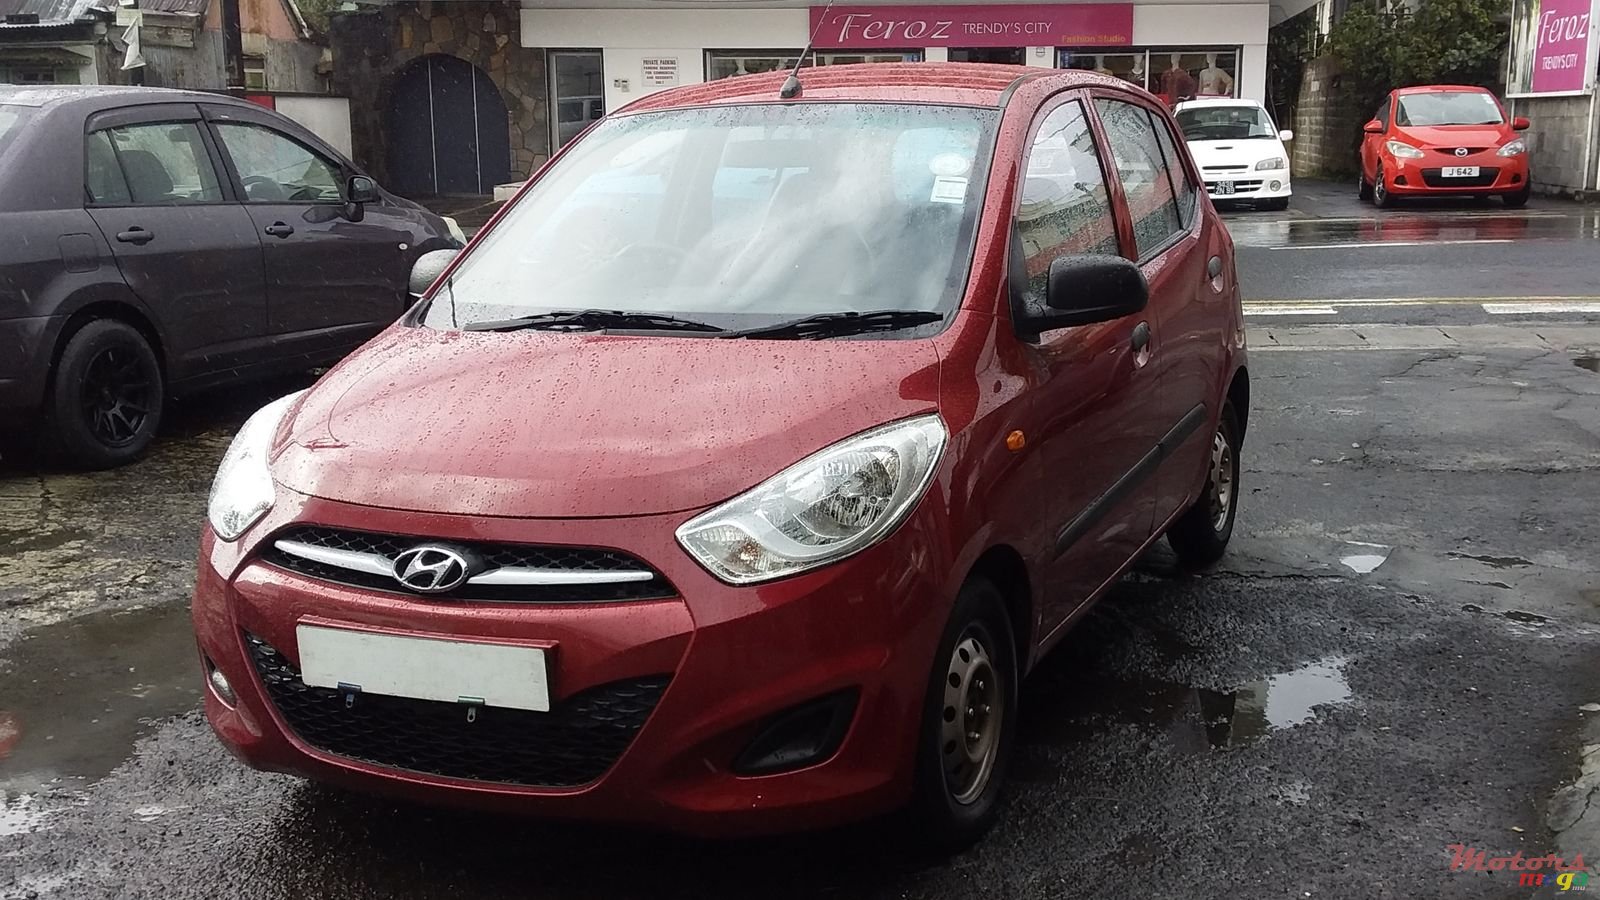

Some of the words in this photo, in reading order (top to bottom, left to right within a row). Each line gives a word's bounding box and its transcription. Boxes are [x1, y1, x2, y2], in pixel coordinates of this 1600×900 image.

[832, 13, 953, 42] Feroz
[963, 22, 1021, 34] TRENDY'S
[1024, 22, 1052, 34] CITY
[1538, 9, 1589, 48] Feroz
[1061, 35, 1096, 43] Fashion
[1097, 34, 1126, 43] Studio
[1456, 167, 1473, 176] 642
